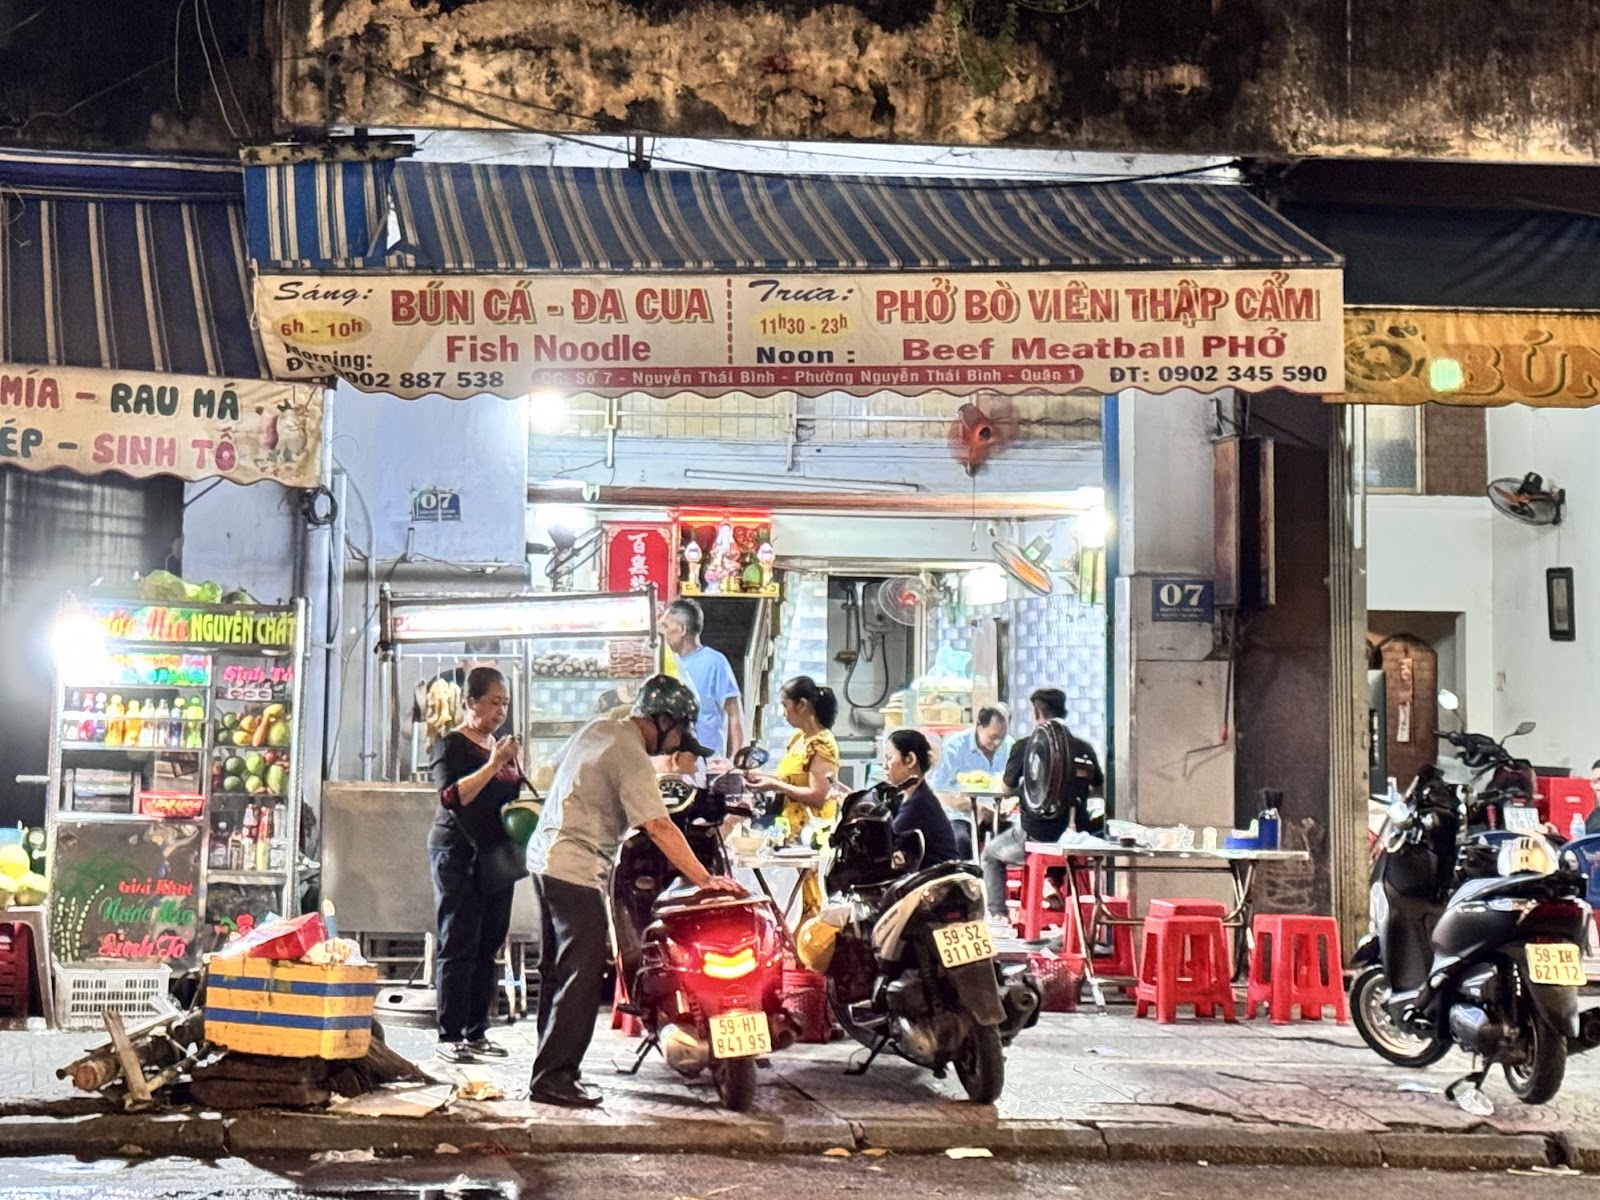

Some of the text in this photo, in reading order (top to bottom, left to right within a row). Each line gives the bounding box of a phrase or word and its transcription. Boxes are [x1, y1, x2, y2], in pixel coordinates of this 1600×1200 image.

[274, 281, 374, 306] Sáng:
[391, 280, 475, 325] BÚN
[483, 280, 535, 324] CÁ
[572, 288, 628, 324] ĐA
[635, 288, 714, 323] CUA
[749, 280, 853, 302] Trưa:
[876, 271, 1320, 328] PHỞ BÒ VIÊN THẬP CẨM
[281, 319, 304, 337] 6h
[328, 318, 363, 338] 10h
[760, 313, 805, 335] 11h30
[821, 313, 848, 335] 23h
[447, 334, 651, 363] Fish Noodle
[903, 328, 1287, 361] Beef Meatball PHỞ
[400, 371, 451, 389] 887
[458, 370, 504, 388] 538
[575, 370, 597, 385] Số
[603, 372, 613, 384] 7
[633, 369, 692, 387] Nguyễn
[700, 371, 733, 384] Thái
[741, 370, 775, 384] Bình
[796, 370, 853, 386] Phường
[861, 369, 918, 385] Nguyễn
[926, 369, 960, 383] Thái
[968, 368, 1000, 383] Bình
[1021, 368, 1063, 384] Quận
[1070, 369, 1076, 380] 1
[1110, 366, 1327, 382] ĐT: 0902 345 590
[0, 369, 59, 408] MÍA
[111, 383, 178, 416] RAU
[193, 382, 239, 420] MÁ
[92, 433, 176, 468] SINH
[192, 426, 236, 471] TỐ
[421, 493, 453, 509] 07
[1160, 584, 1204, 606] 07
[190, 610, 253, 643] NGUYÊN
